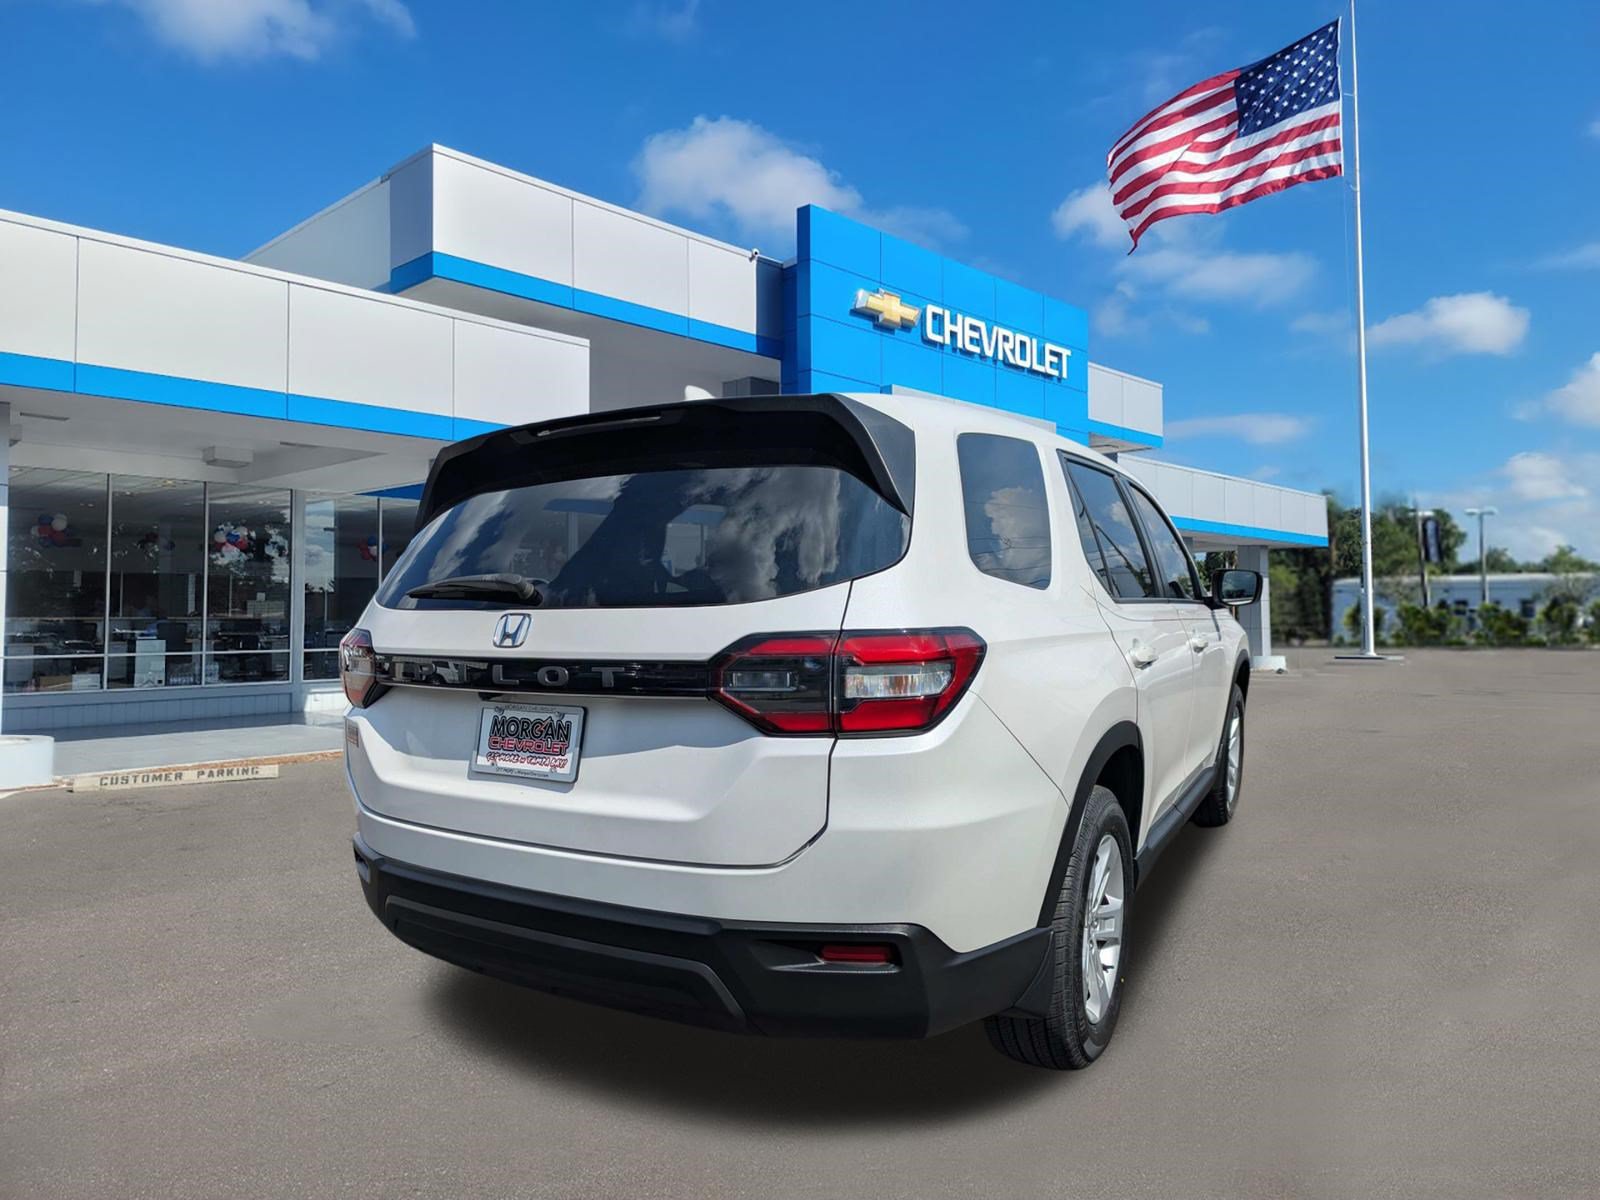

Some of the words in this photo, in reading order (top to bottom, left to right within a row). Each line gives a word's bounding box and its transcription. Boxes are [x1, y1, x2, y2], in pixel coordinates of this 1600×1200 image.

[926, 304, 1072, 379] CHEVROLET
[490, 715, 572, 743] MORGAN
[489, 737, 569, 756] CHEVROLET
[100, 771, 183, 787] CUSTOMER
[197, 766, 259, 779] PARKING
